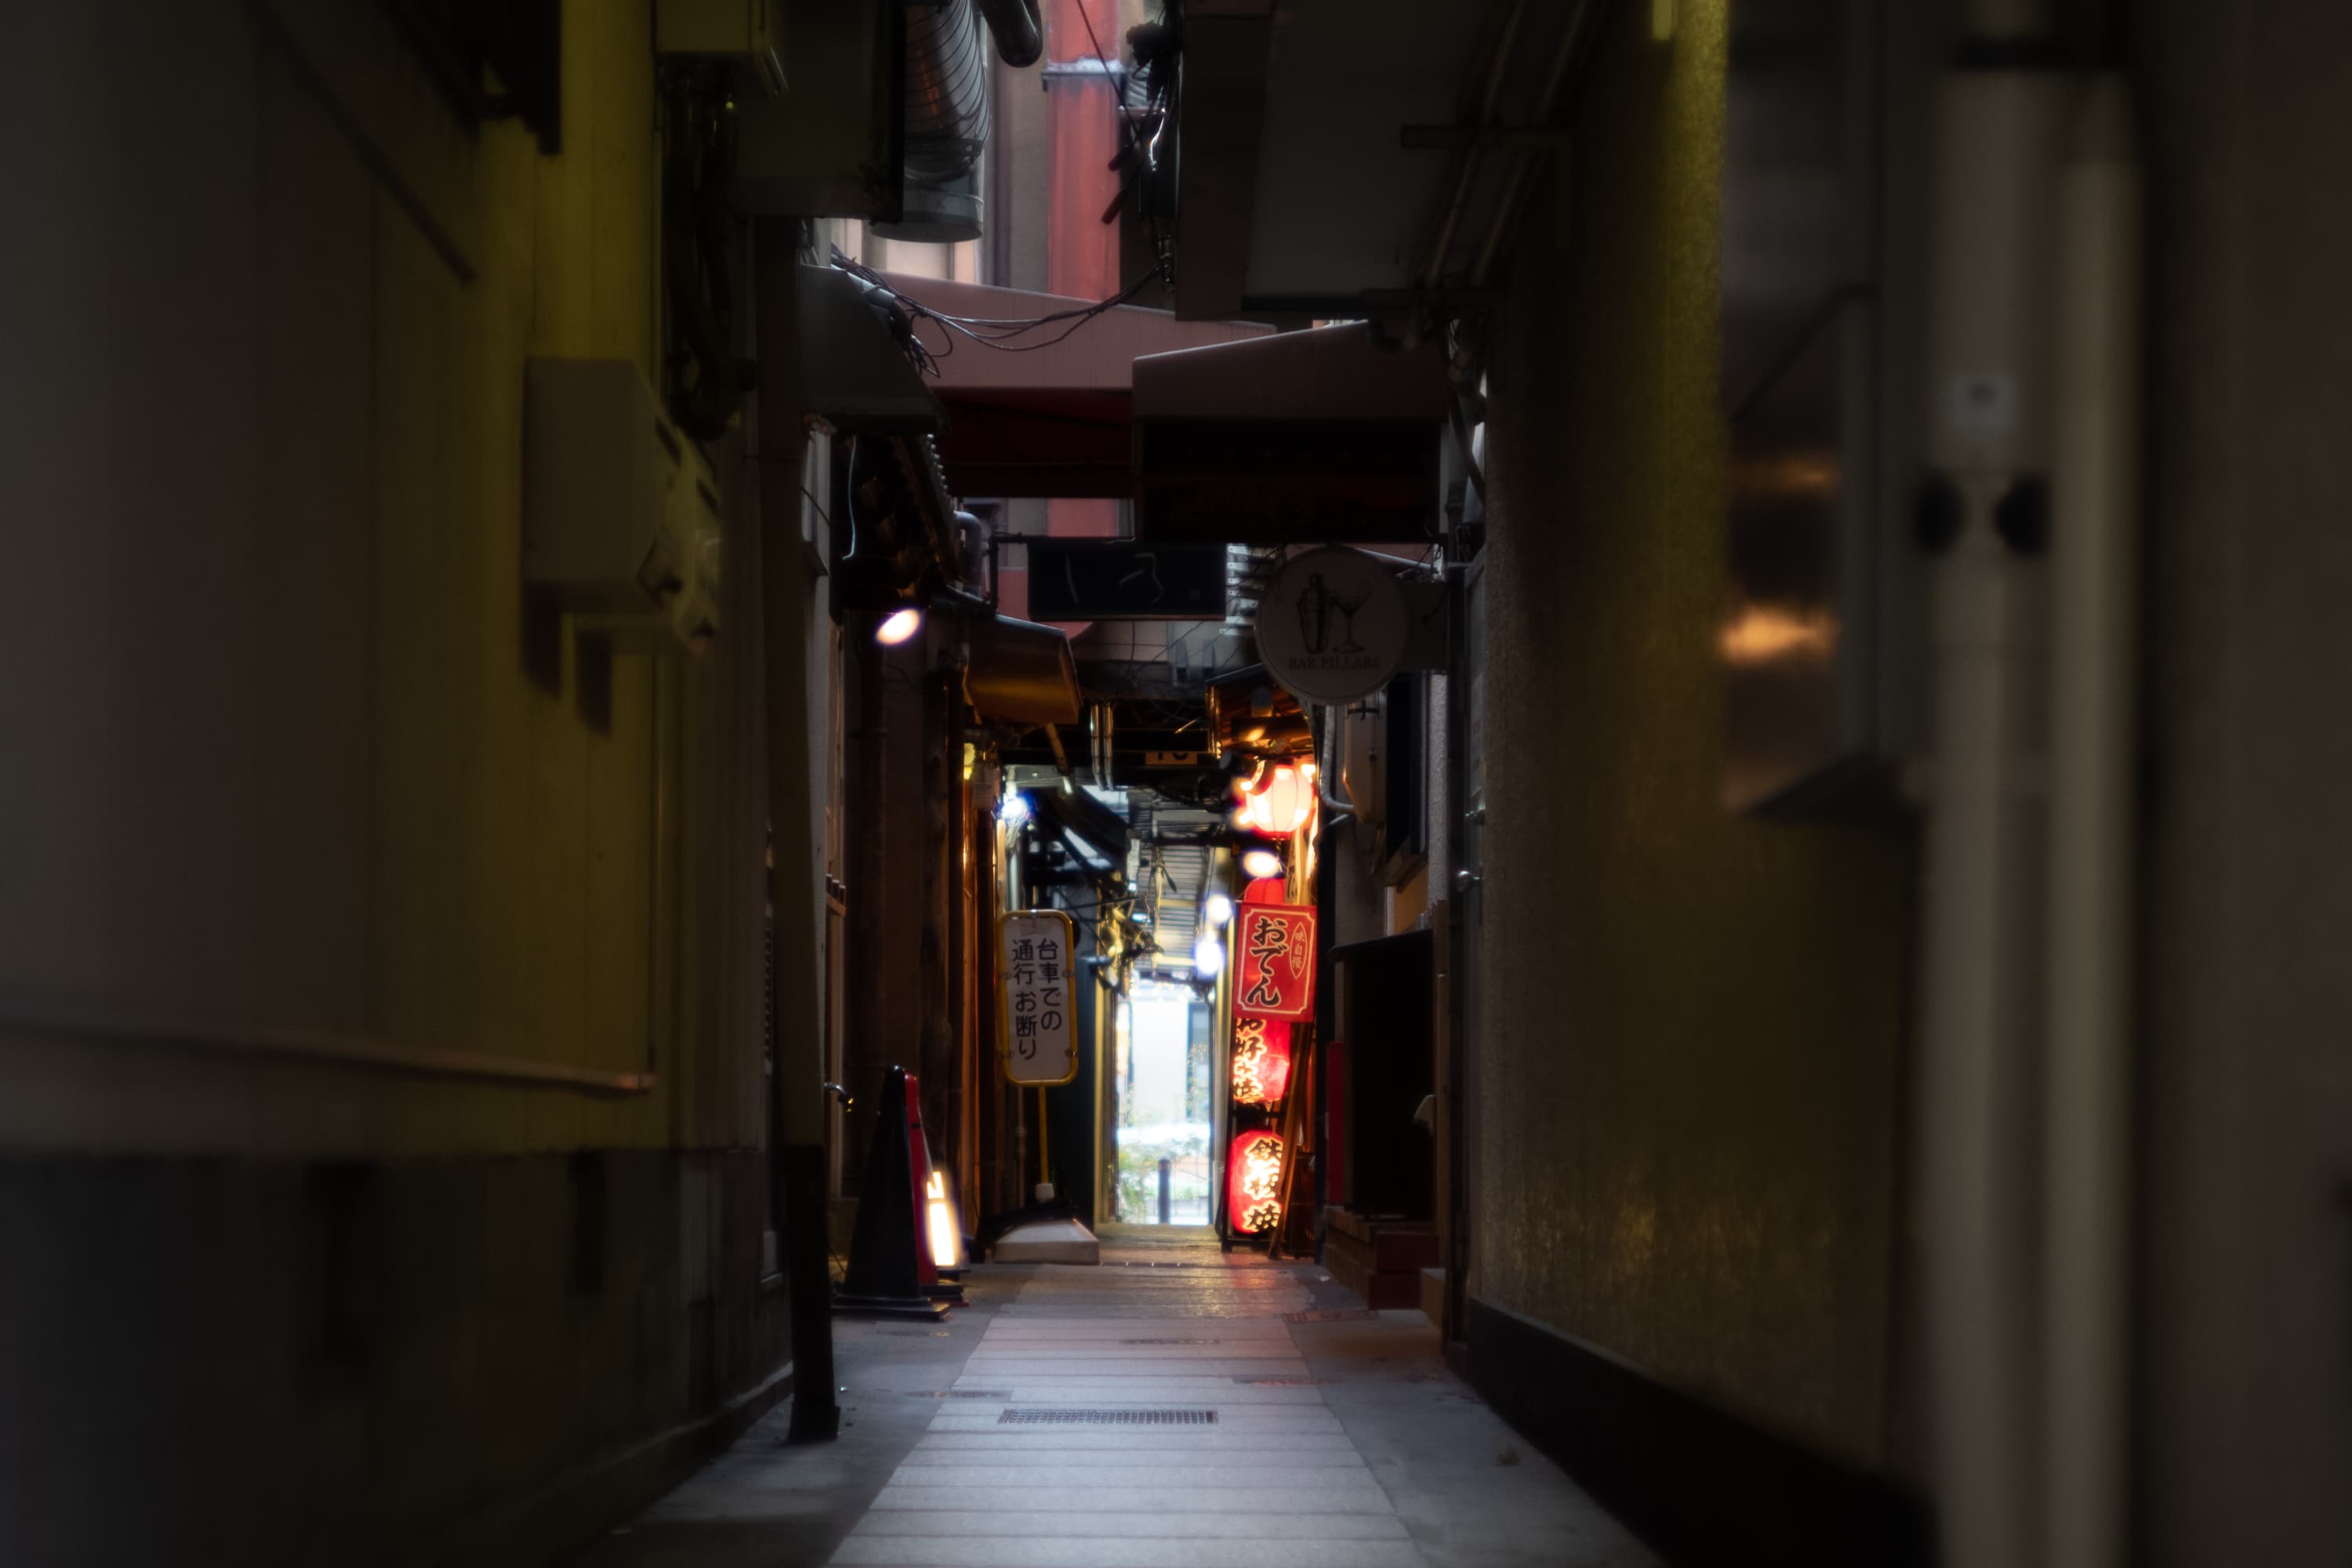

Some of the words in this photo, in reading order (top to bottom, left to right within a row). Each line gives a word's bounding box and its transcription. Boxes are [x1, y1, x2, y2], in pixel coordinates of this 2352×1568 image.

[1288, 656, 1316, 670] BAR
[1320, 656, 1381, 670] PILLARS
[1036, 938, 1062, 1031] 台車での
[1246, 916, 1289, 1006] おでん
[1292, 932, 1305, 969] 味自慢
[1012, 938, 1037, 1060] 通行お断り
